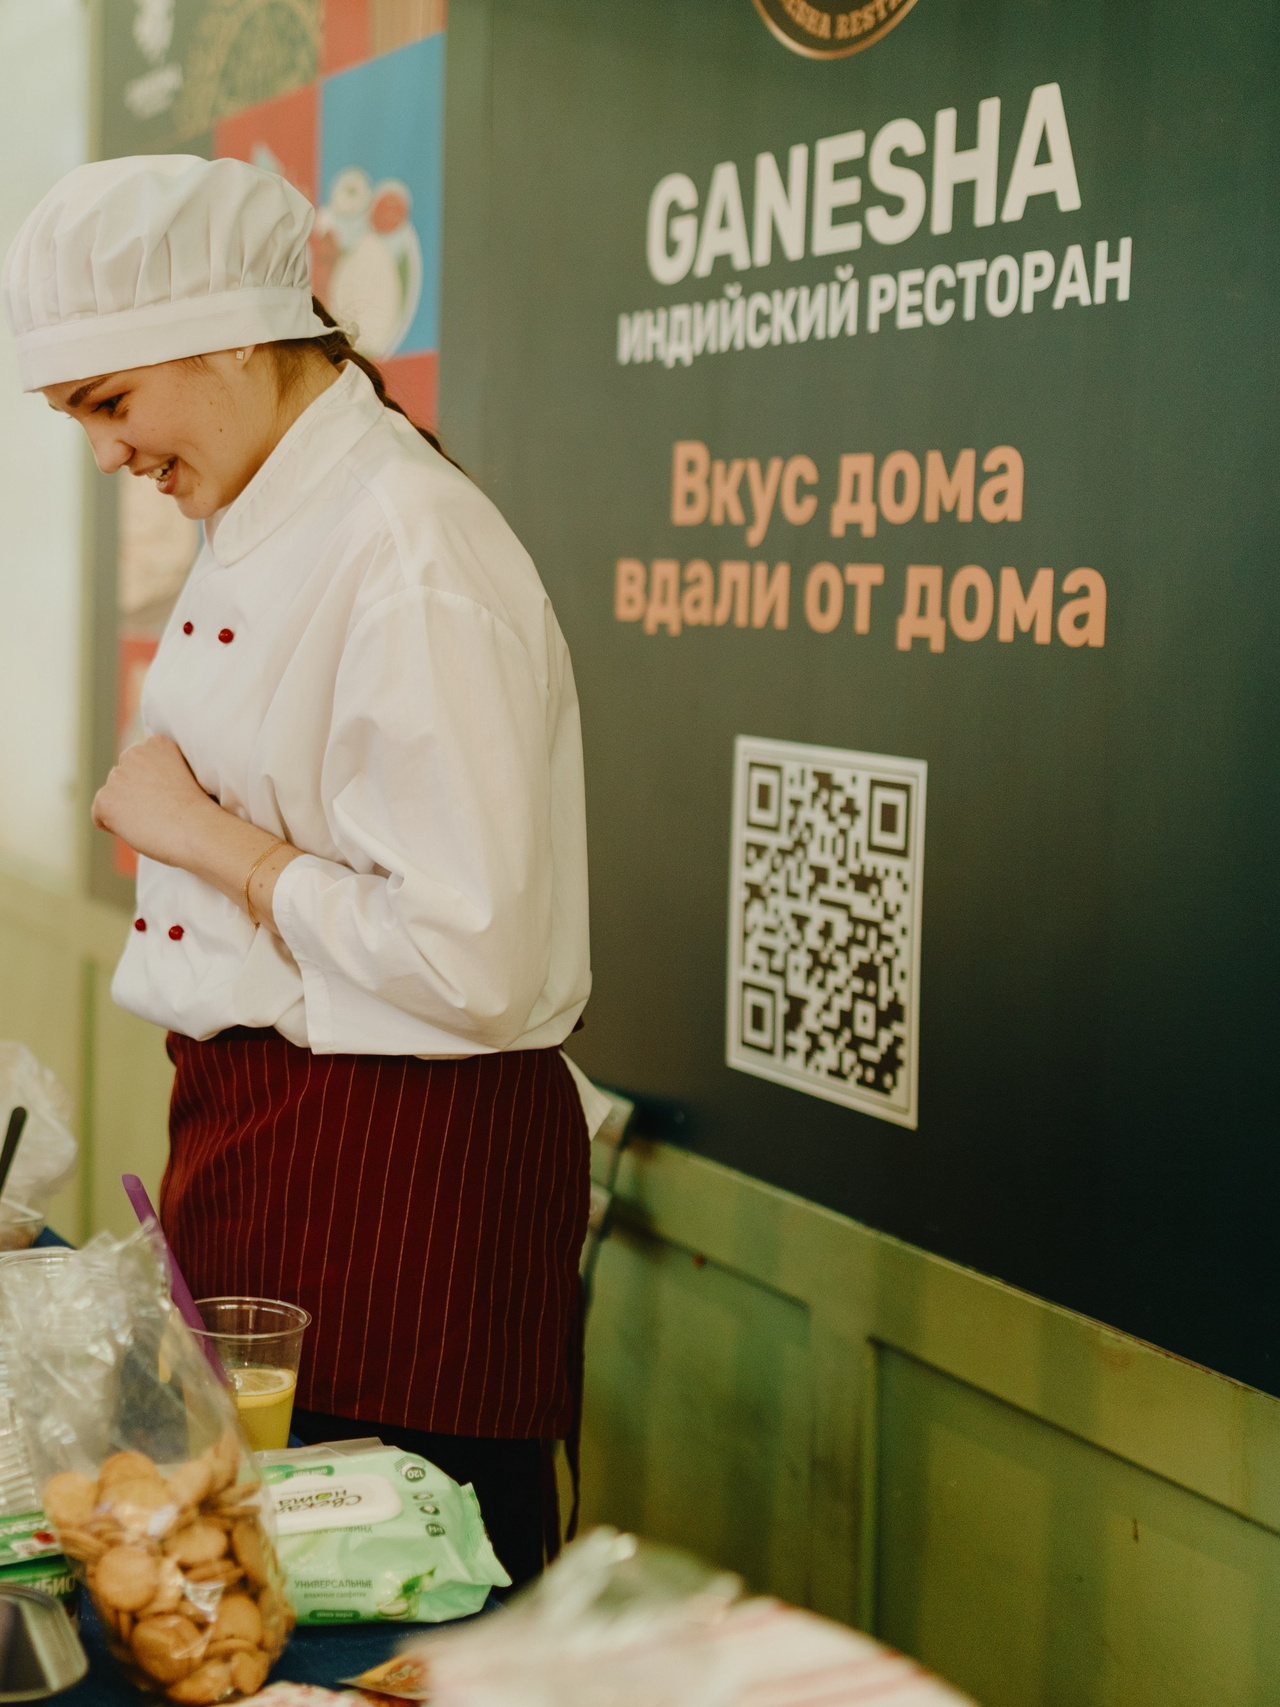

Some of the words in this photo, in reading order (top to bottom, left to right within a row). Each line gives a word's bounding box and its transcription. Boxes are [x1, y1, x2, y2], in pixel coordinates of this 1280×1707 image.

[646, 81, 1082, 286] GANESHA
[616, 264, 859, 368] ИНДИЙСКИЙ
[867, 236, 1133, 333] РЕСТОРАН
[671, 440, 819, 547] Вкус
[831, 445, 1024, 537] дома
[614, 558, 790, 637] вдали
[804, 561, 885, 634] от
[897, 564, 1108, 653] дома
[407, 1470, 424, 1479] 120
[294, 1579, 374, 1590] УНИВЕРСАЛЬНЫЕ
